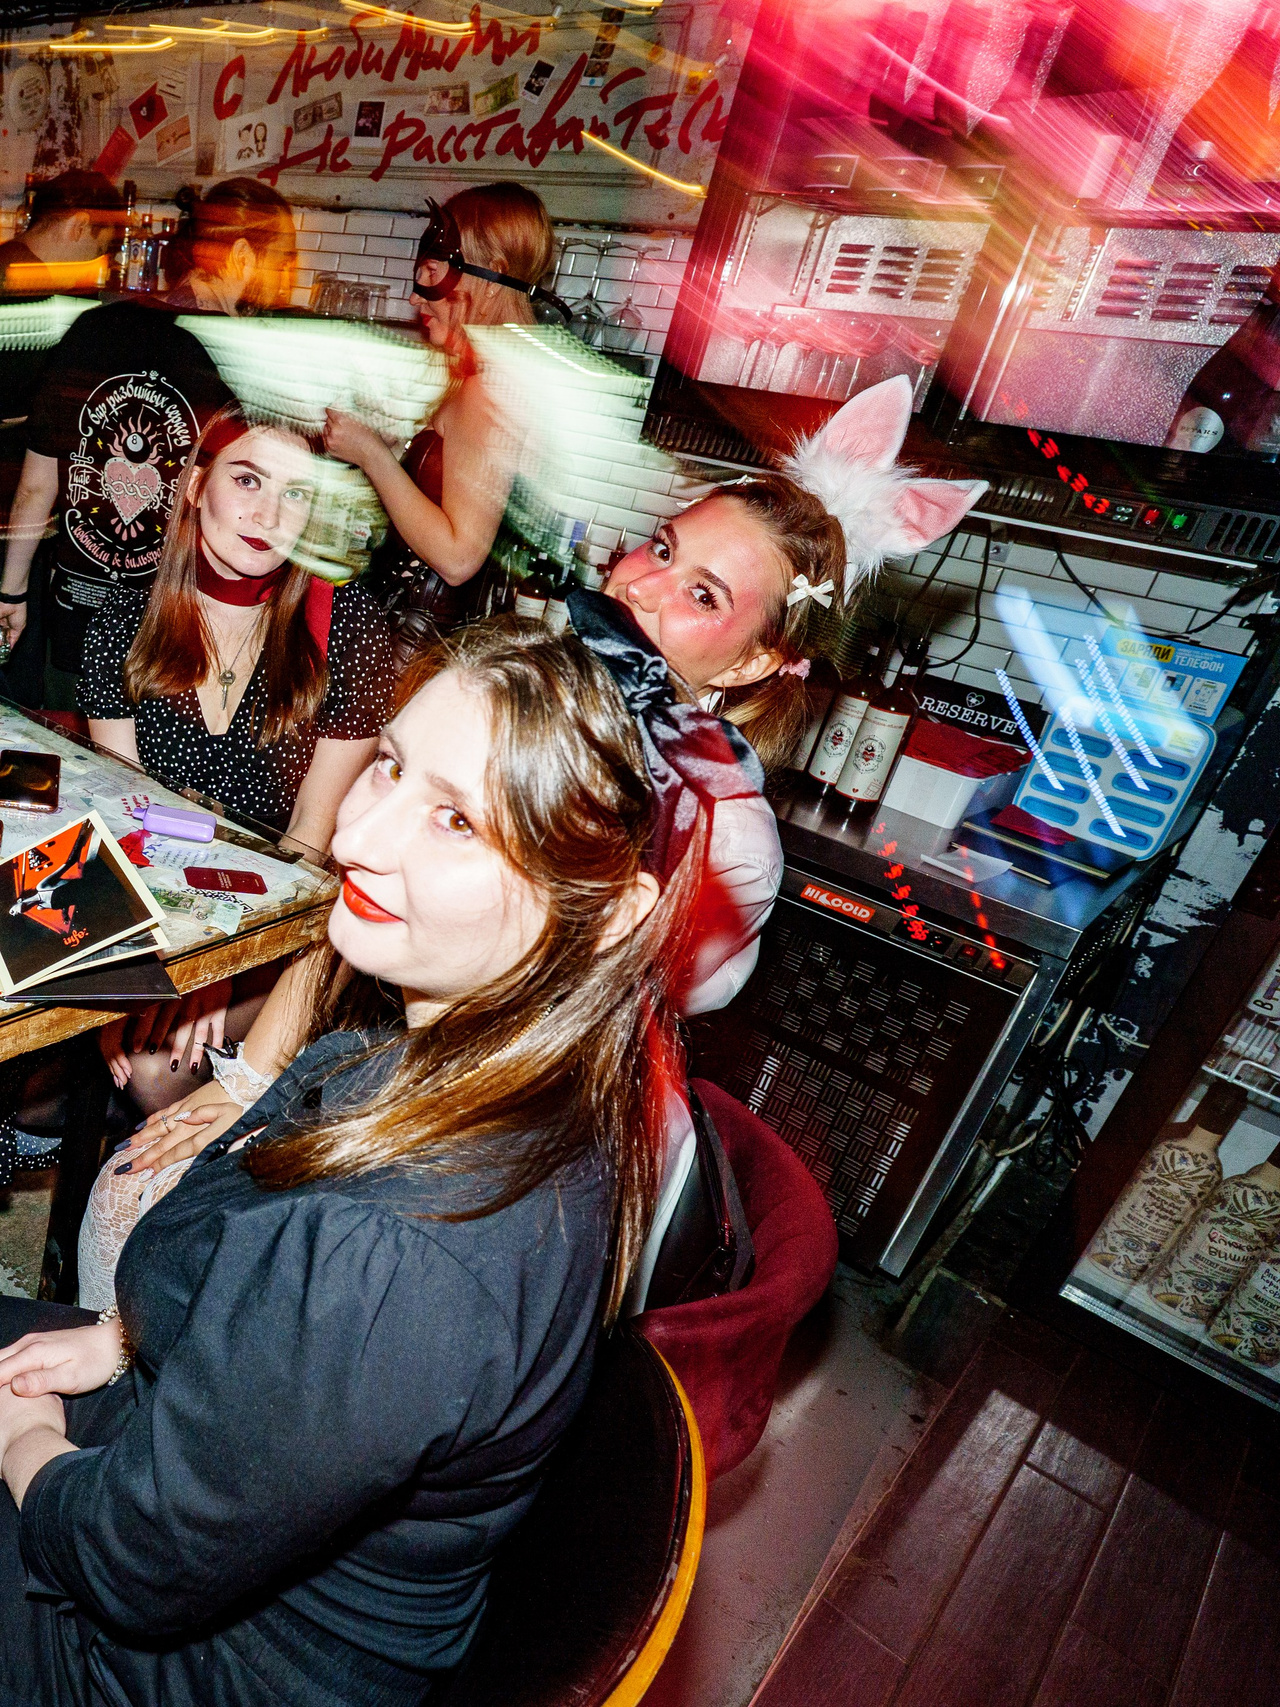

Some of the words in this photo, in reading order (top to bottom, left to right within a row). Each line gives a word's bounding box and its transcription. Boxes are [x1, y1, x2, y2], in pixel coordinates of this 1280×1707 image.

[213, 54, 246, 121] С
[86, 402, 110, 425] бар
[105, 376, 170, 417] разбитых
[163, 404, 192, 447] сердец
[73, 467, 94, 485] hate
[73, 522, 111, 563] коктейли
[1120, 640, 1173, 661] ЗАРЯДИ
[1174, 654, 1226, 673] ТЕЛЕФОН
[919, 696, 1019, 736] RESERVE
[804, 886, 871, 919] HICOLD
[63, 927, 89, 948] info:
